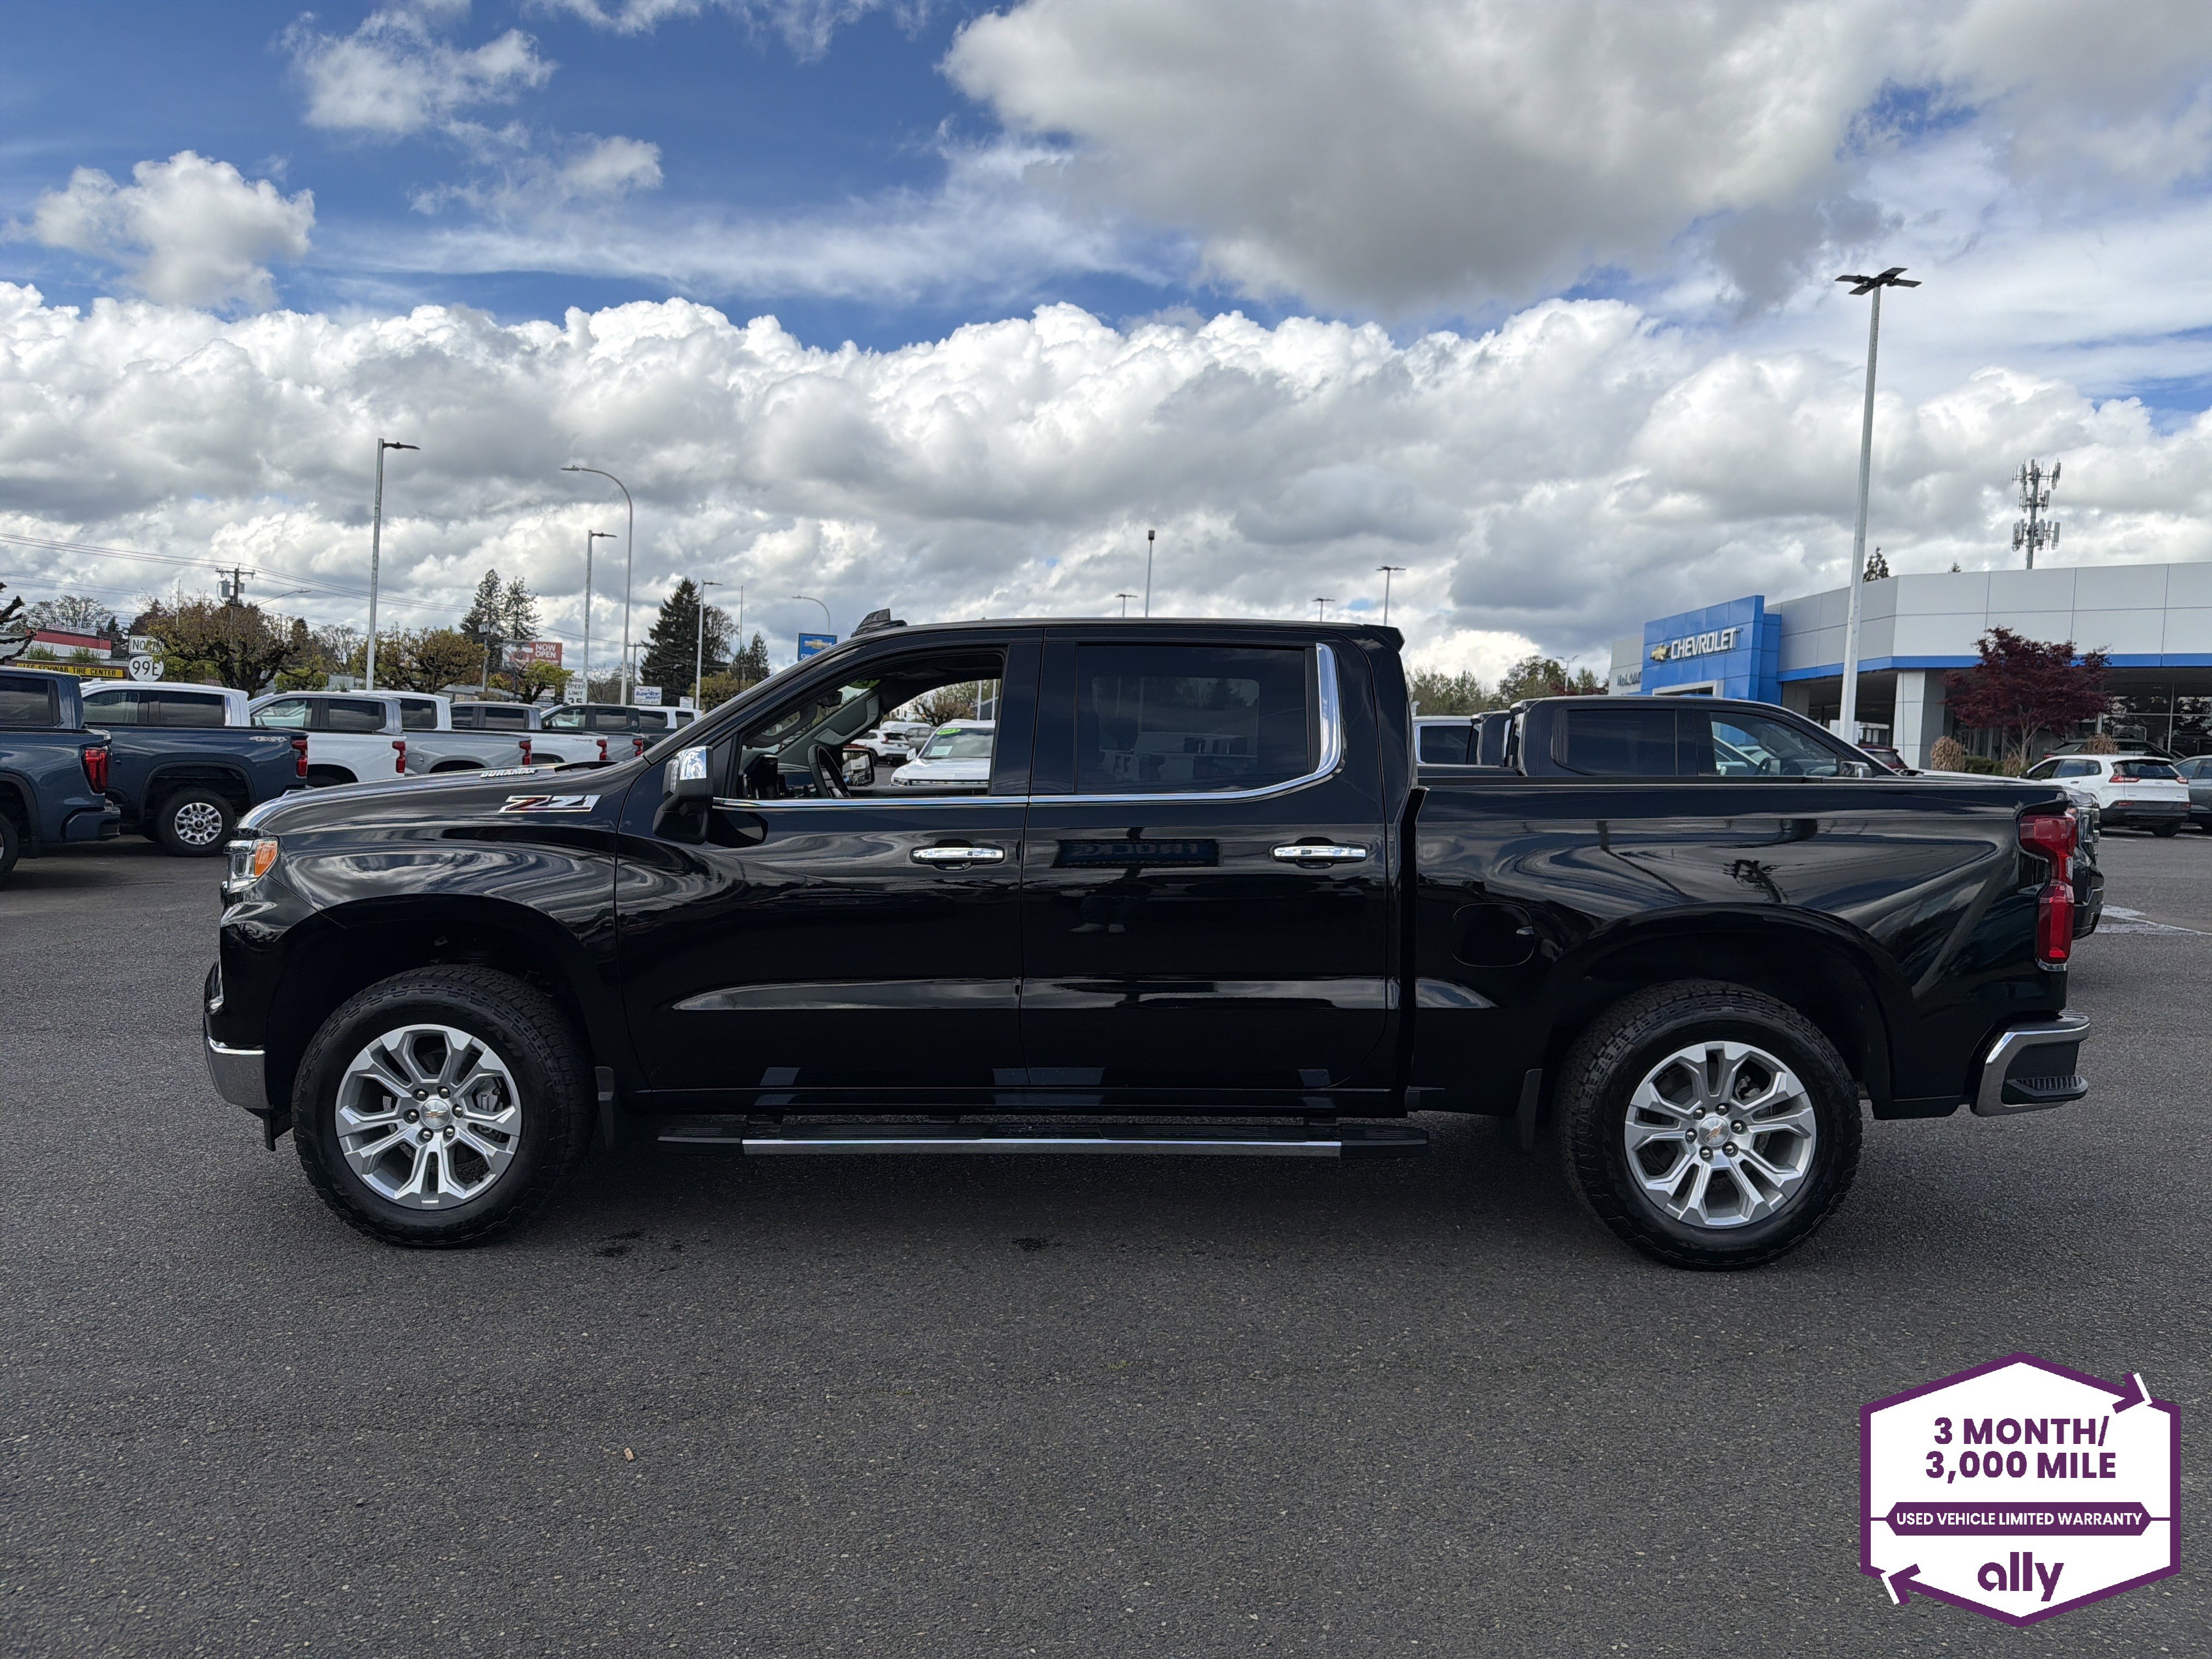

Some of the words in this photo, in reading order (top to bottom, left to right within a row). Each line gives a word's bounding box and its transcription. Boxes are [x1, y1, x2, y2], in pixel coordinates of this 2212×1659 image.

[535, 644, 556, 652] NOW
[1671, 628, 1736, 659] CHEVROLET
[90, 668, 116, 676] CENTER
[132, 660, 160, 676] 99E
[479, 768, 538, 778] DURAMAX
[498, 795, 601, 814] Z71
